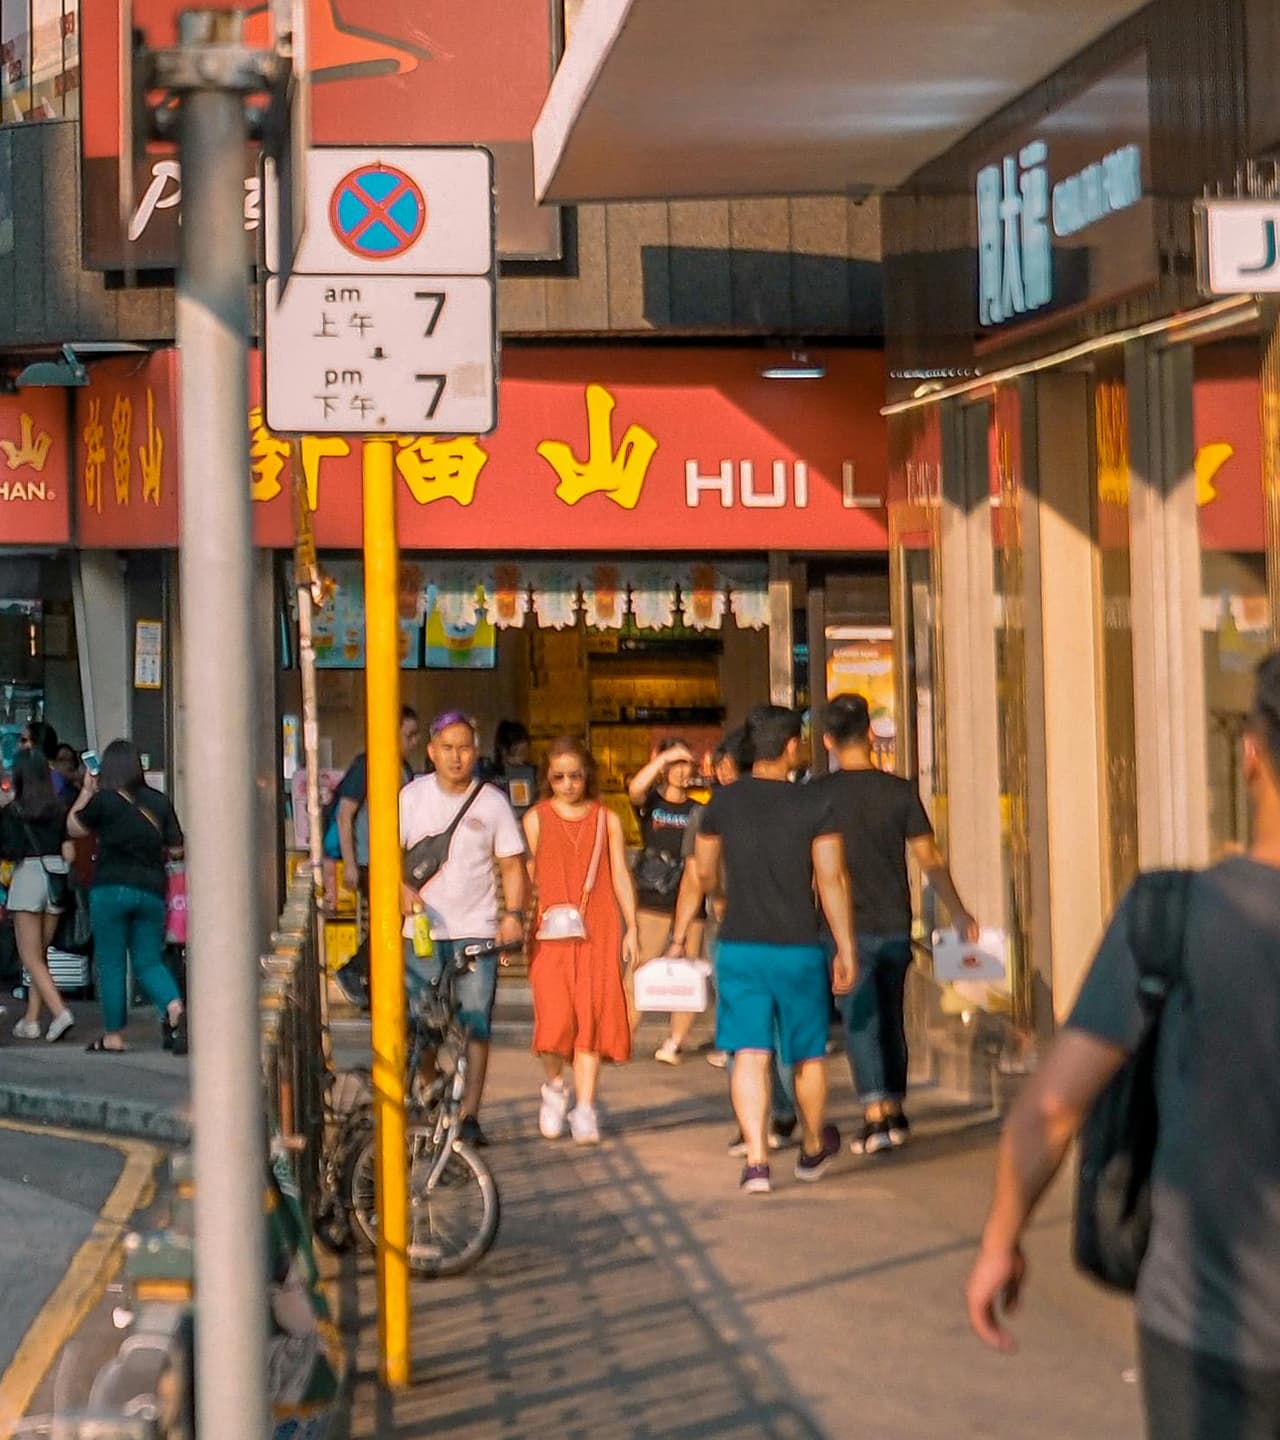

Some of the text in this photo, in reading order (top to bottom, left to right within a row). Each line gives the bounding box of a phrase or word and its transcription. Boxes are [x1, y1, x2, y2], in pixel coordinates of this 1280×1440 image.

[312, 312, 375, 338] 上午
[324, 287, 447, 338] am 7
[314, 395, 375, 422] 下午
[324, 368, 447, 420] pm 7
[684, 458, 809, 509] HUI
